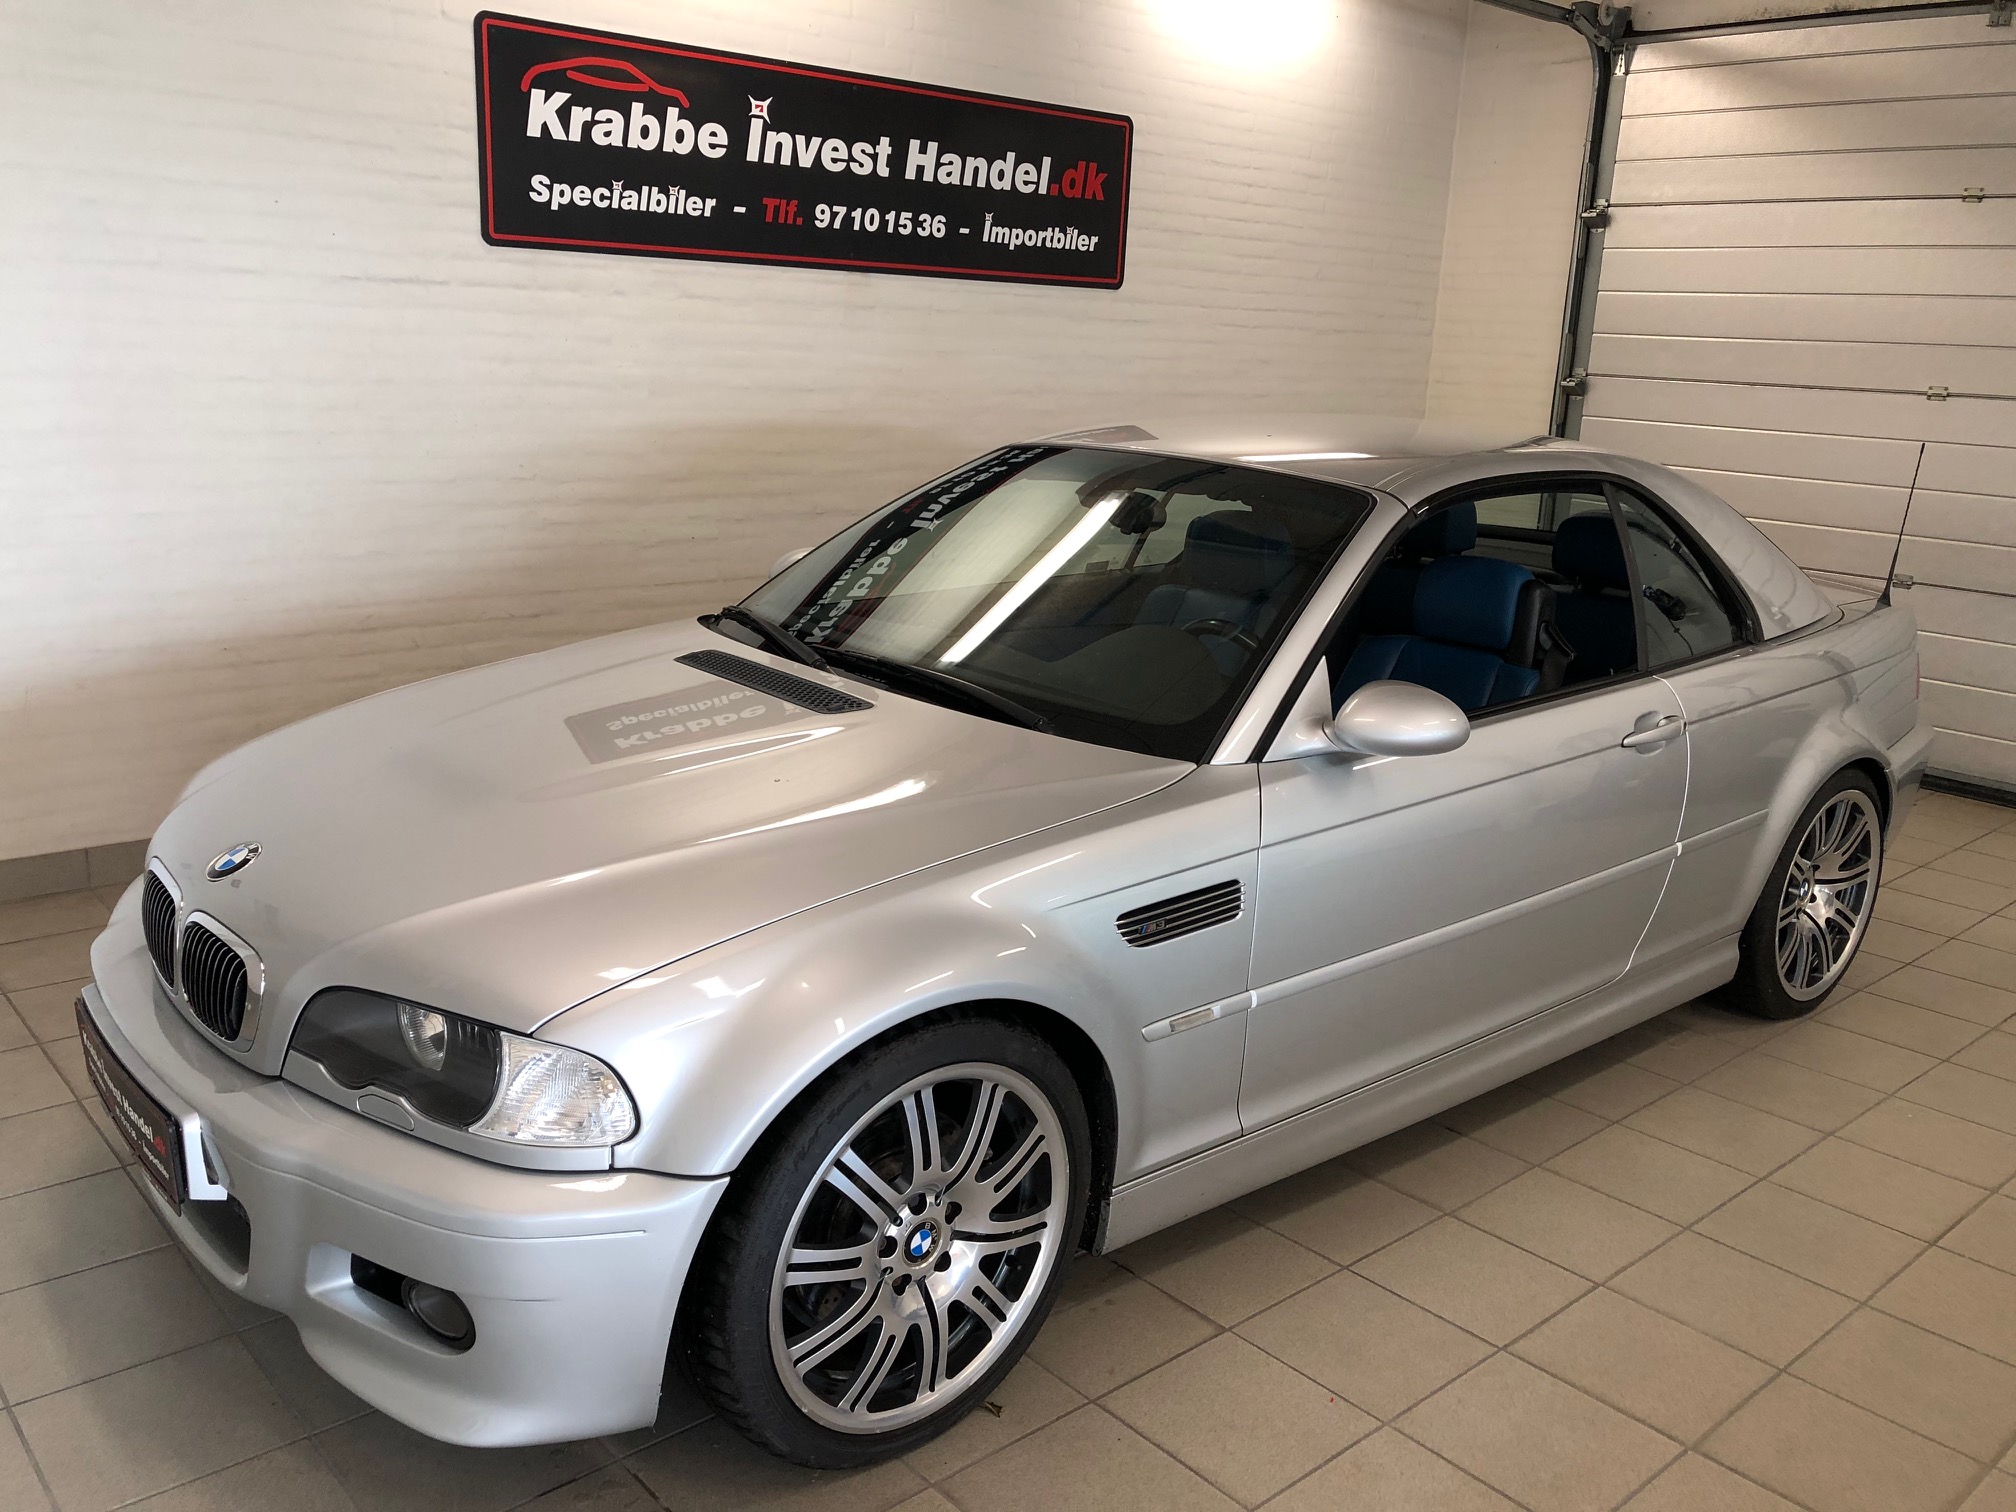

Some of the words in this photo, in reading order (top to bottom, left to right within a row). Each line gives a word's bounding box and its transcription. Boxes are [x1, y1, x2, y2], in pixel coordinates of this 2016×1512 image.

[526, 88, 728, 158] Krabbe
[746, 95, 892, 177] Invest
[904, 138, 1108, 201] Handel.dk
[529, 174, 716, 218] Specialbiler
[733, 205, 747, 214] -
[762, 197, 803, 226] Tlf.
[959, 227, 970, 235] -
[982, 211, 1098, 252] Importbiler
